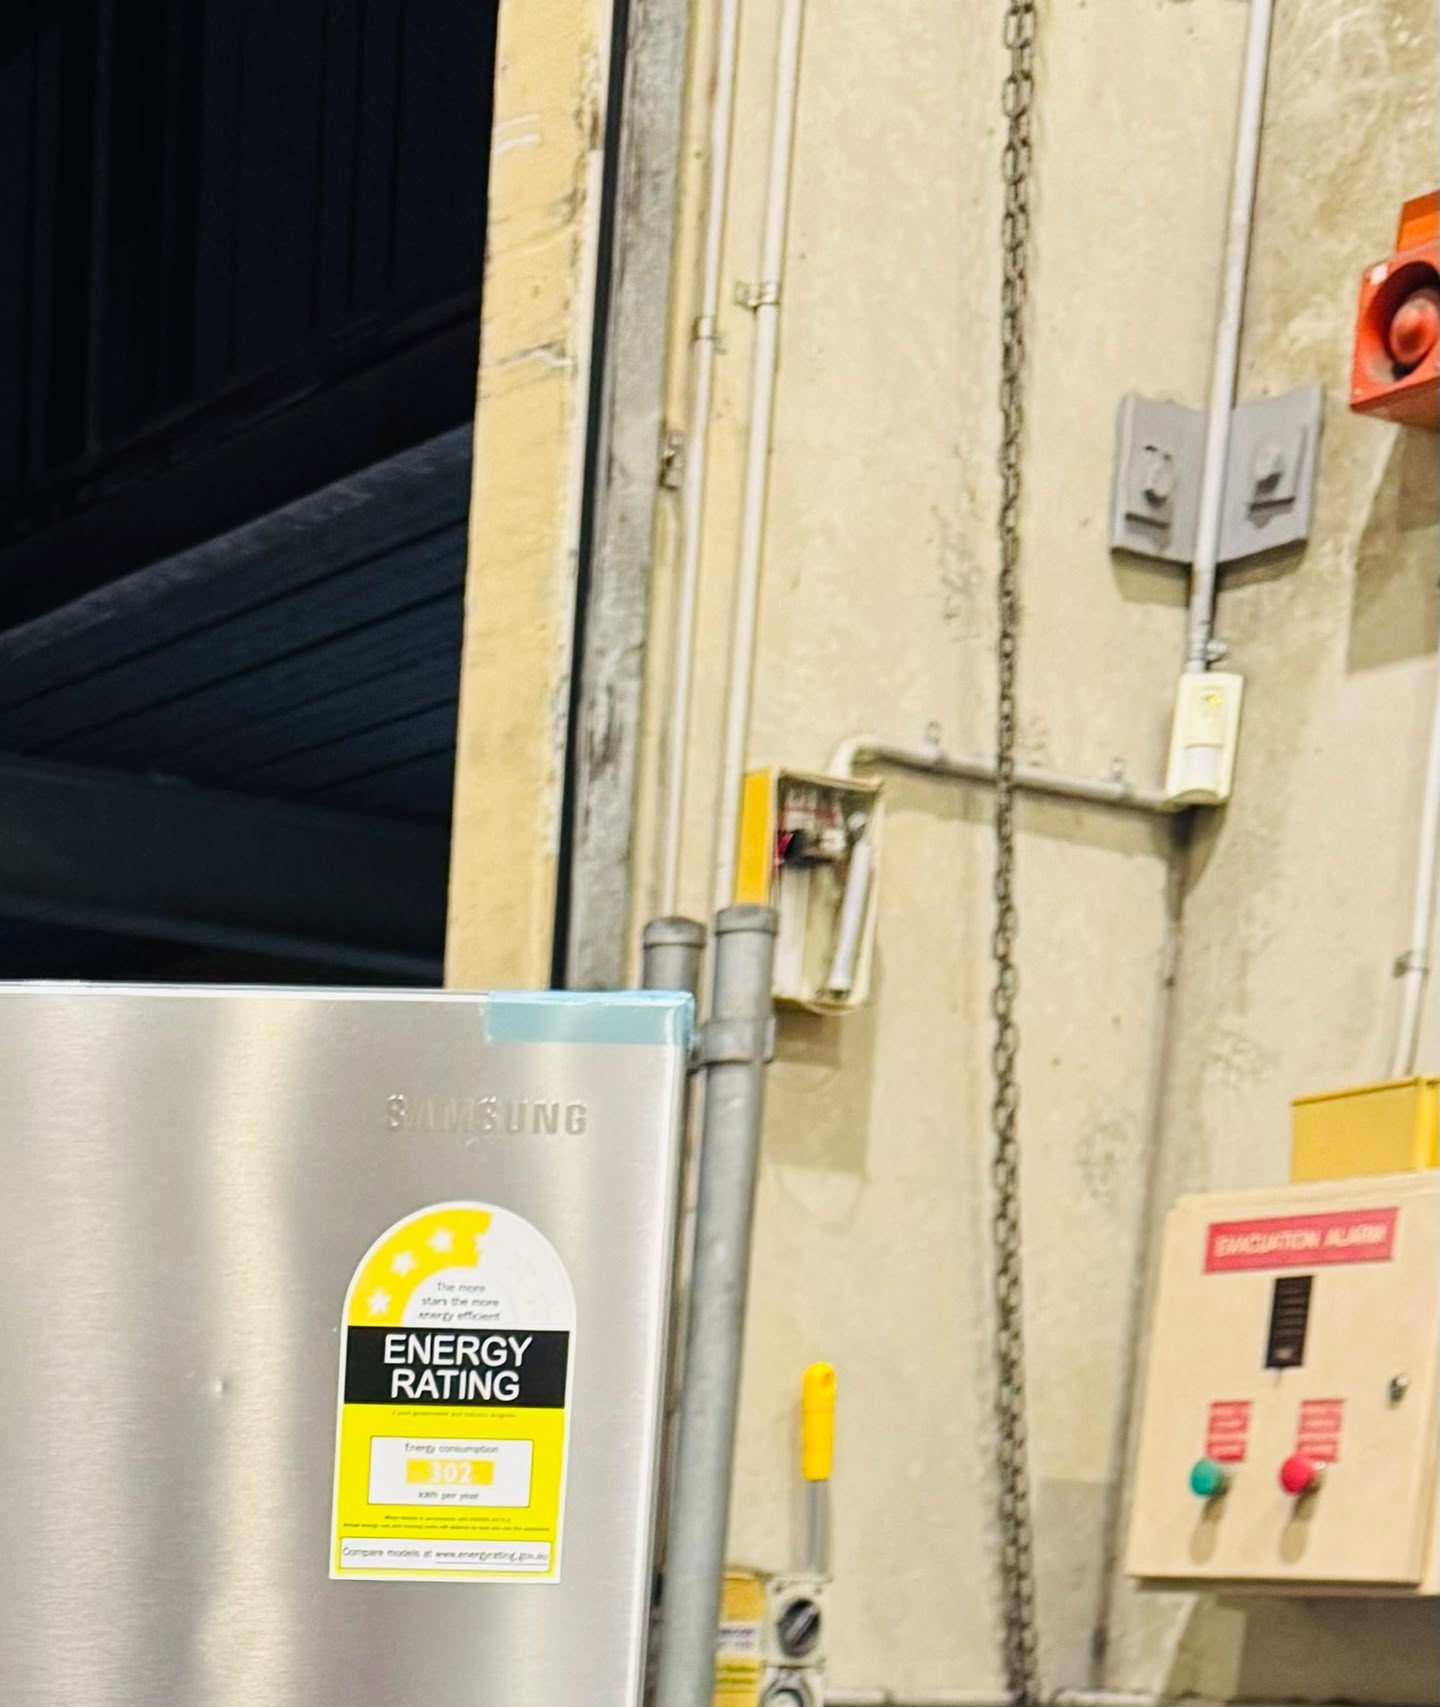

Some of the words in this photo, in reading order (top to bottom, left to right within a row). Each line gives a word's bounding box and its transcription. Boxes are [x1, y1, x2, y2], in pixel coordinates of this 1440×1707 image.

[386, 1094, 588, 1135] SAMSUNG
[1323, 1223, 1387, 1247] ALARM
[384, 1332, 534, 1367] ENERGY
[391, 1368, 520, 1402] RATING
